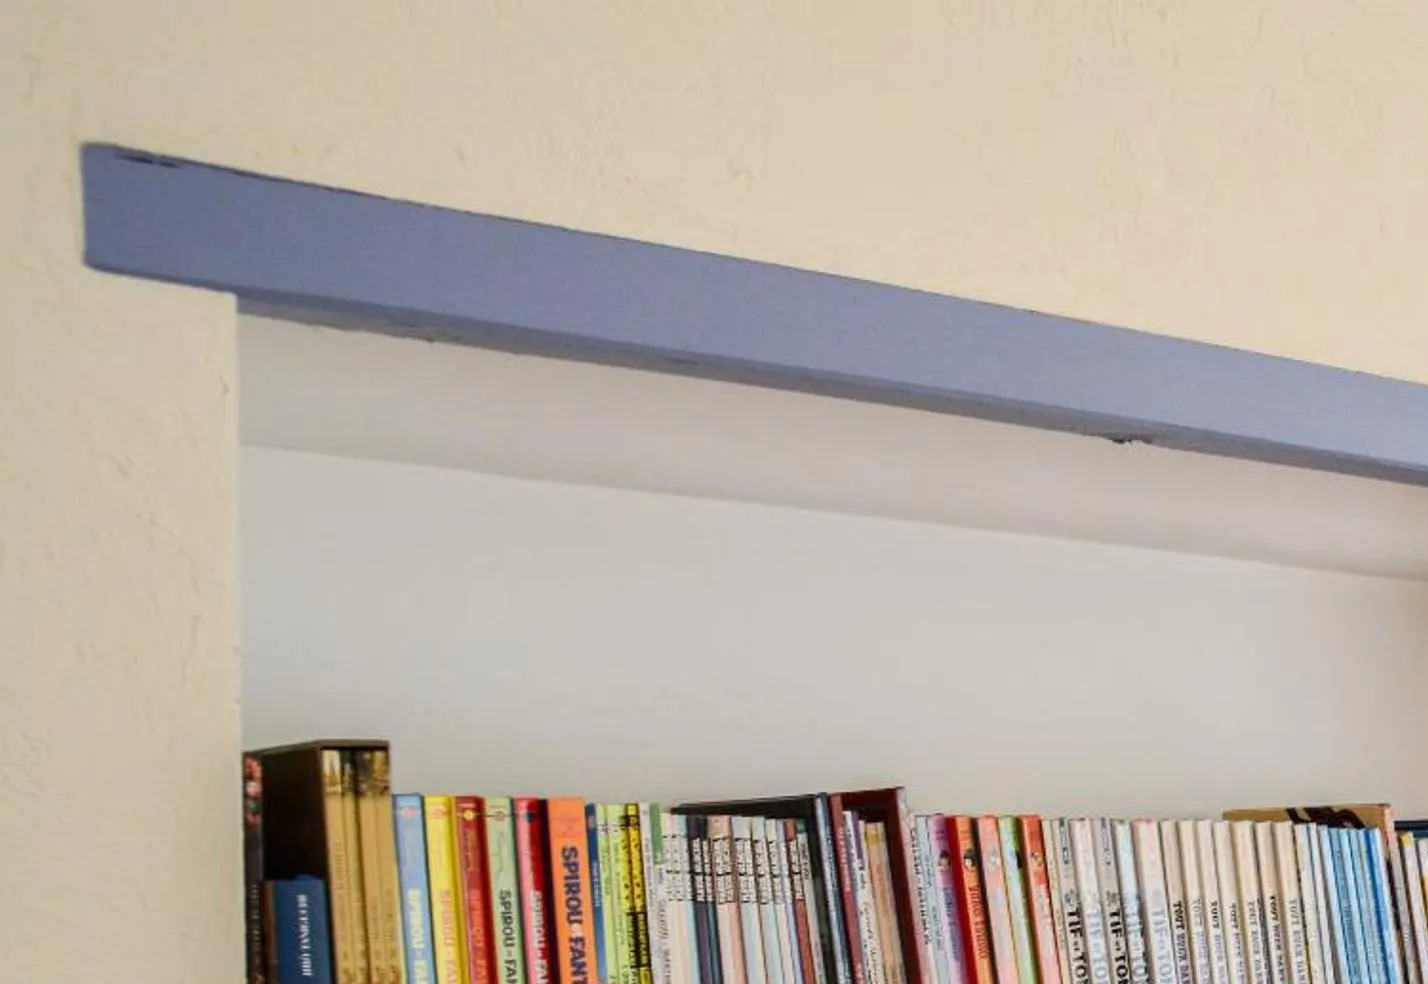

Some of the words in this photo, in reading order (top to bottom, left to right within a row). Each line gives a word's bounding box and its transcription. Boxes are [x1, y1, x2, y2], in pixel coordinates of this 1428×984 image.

[561, 845, 583, 925] SPIROU
[408, 887, 425, 949] SPIROU
[499, 889, 516, 947] SPIROU
[1067, 906, 1083, 937] TIF
[1109, 909, 1124, 937] TIF
[1151, 907, 1169, 937] TIF
[1173, 900, 1186, 930] TOUT
